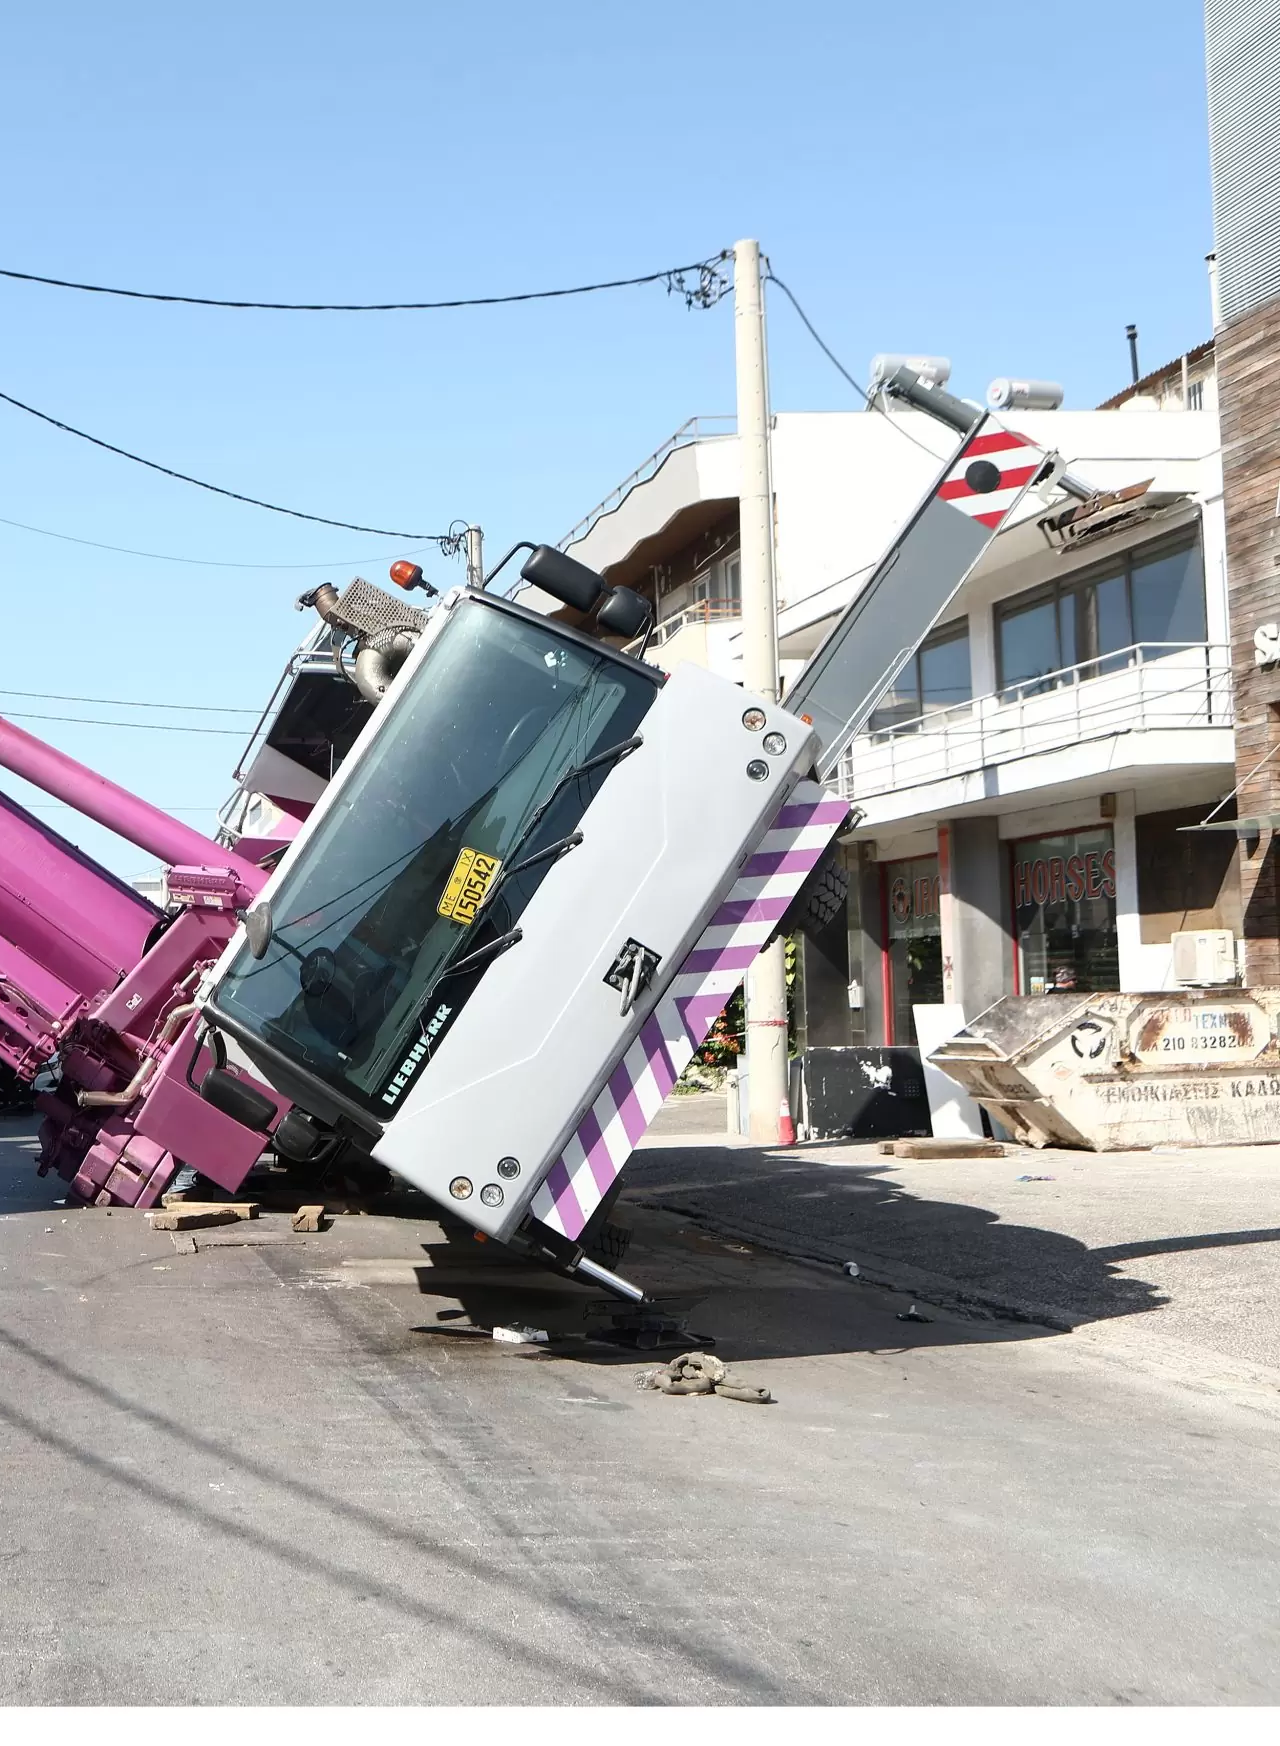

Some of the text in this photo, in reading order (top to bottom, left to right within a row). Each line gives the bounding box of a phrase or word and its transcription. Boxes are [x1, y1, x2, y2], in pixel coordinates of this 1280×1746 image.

[442, 893, 457, 912] ME
[455, 858, 495, 920] 150542
[1015, 848, 1116, 909] HORSES
[382, 1003, 453, 1105] LIEBHERR
[1163, 1037, 1185, 1051] 210
[1191, 1035, 1254, 1050] 83282
